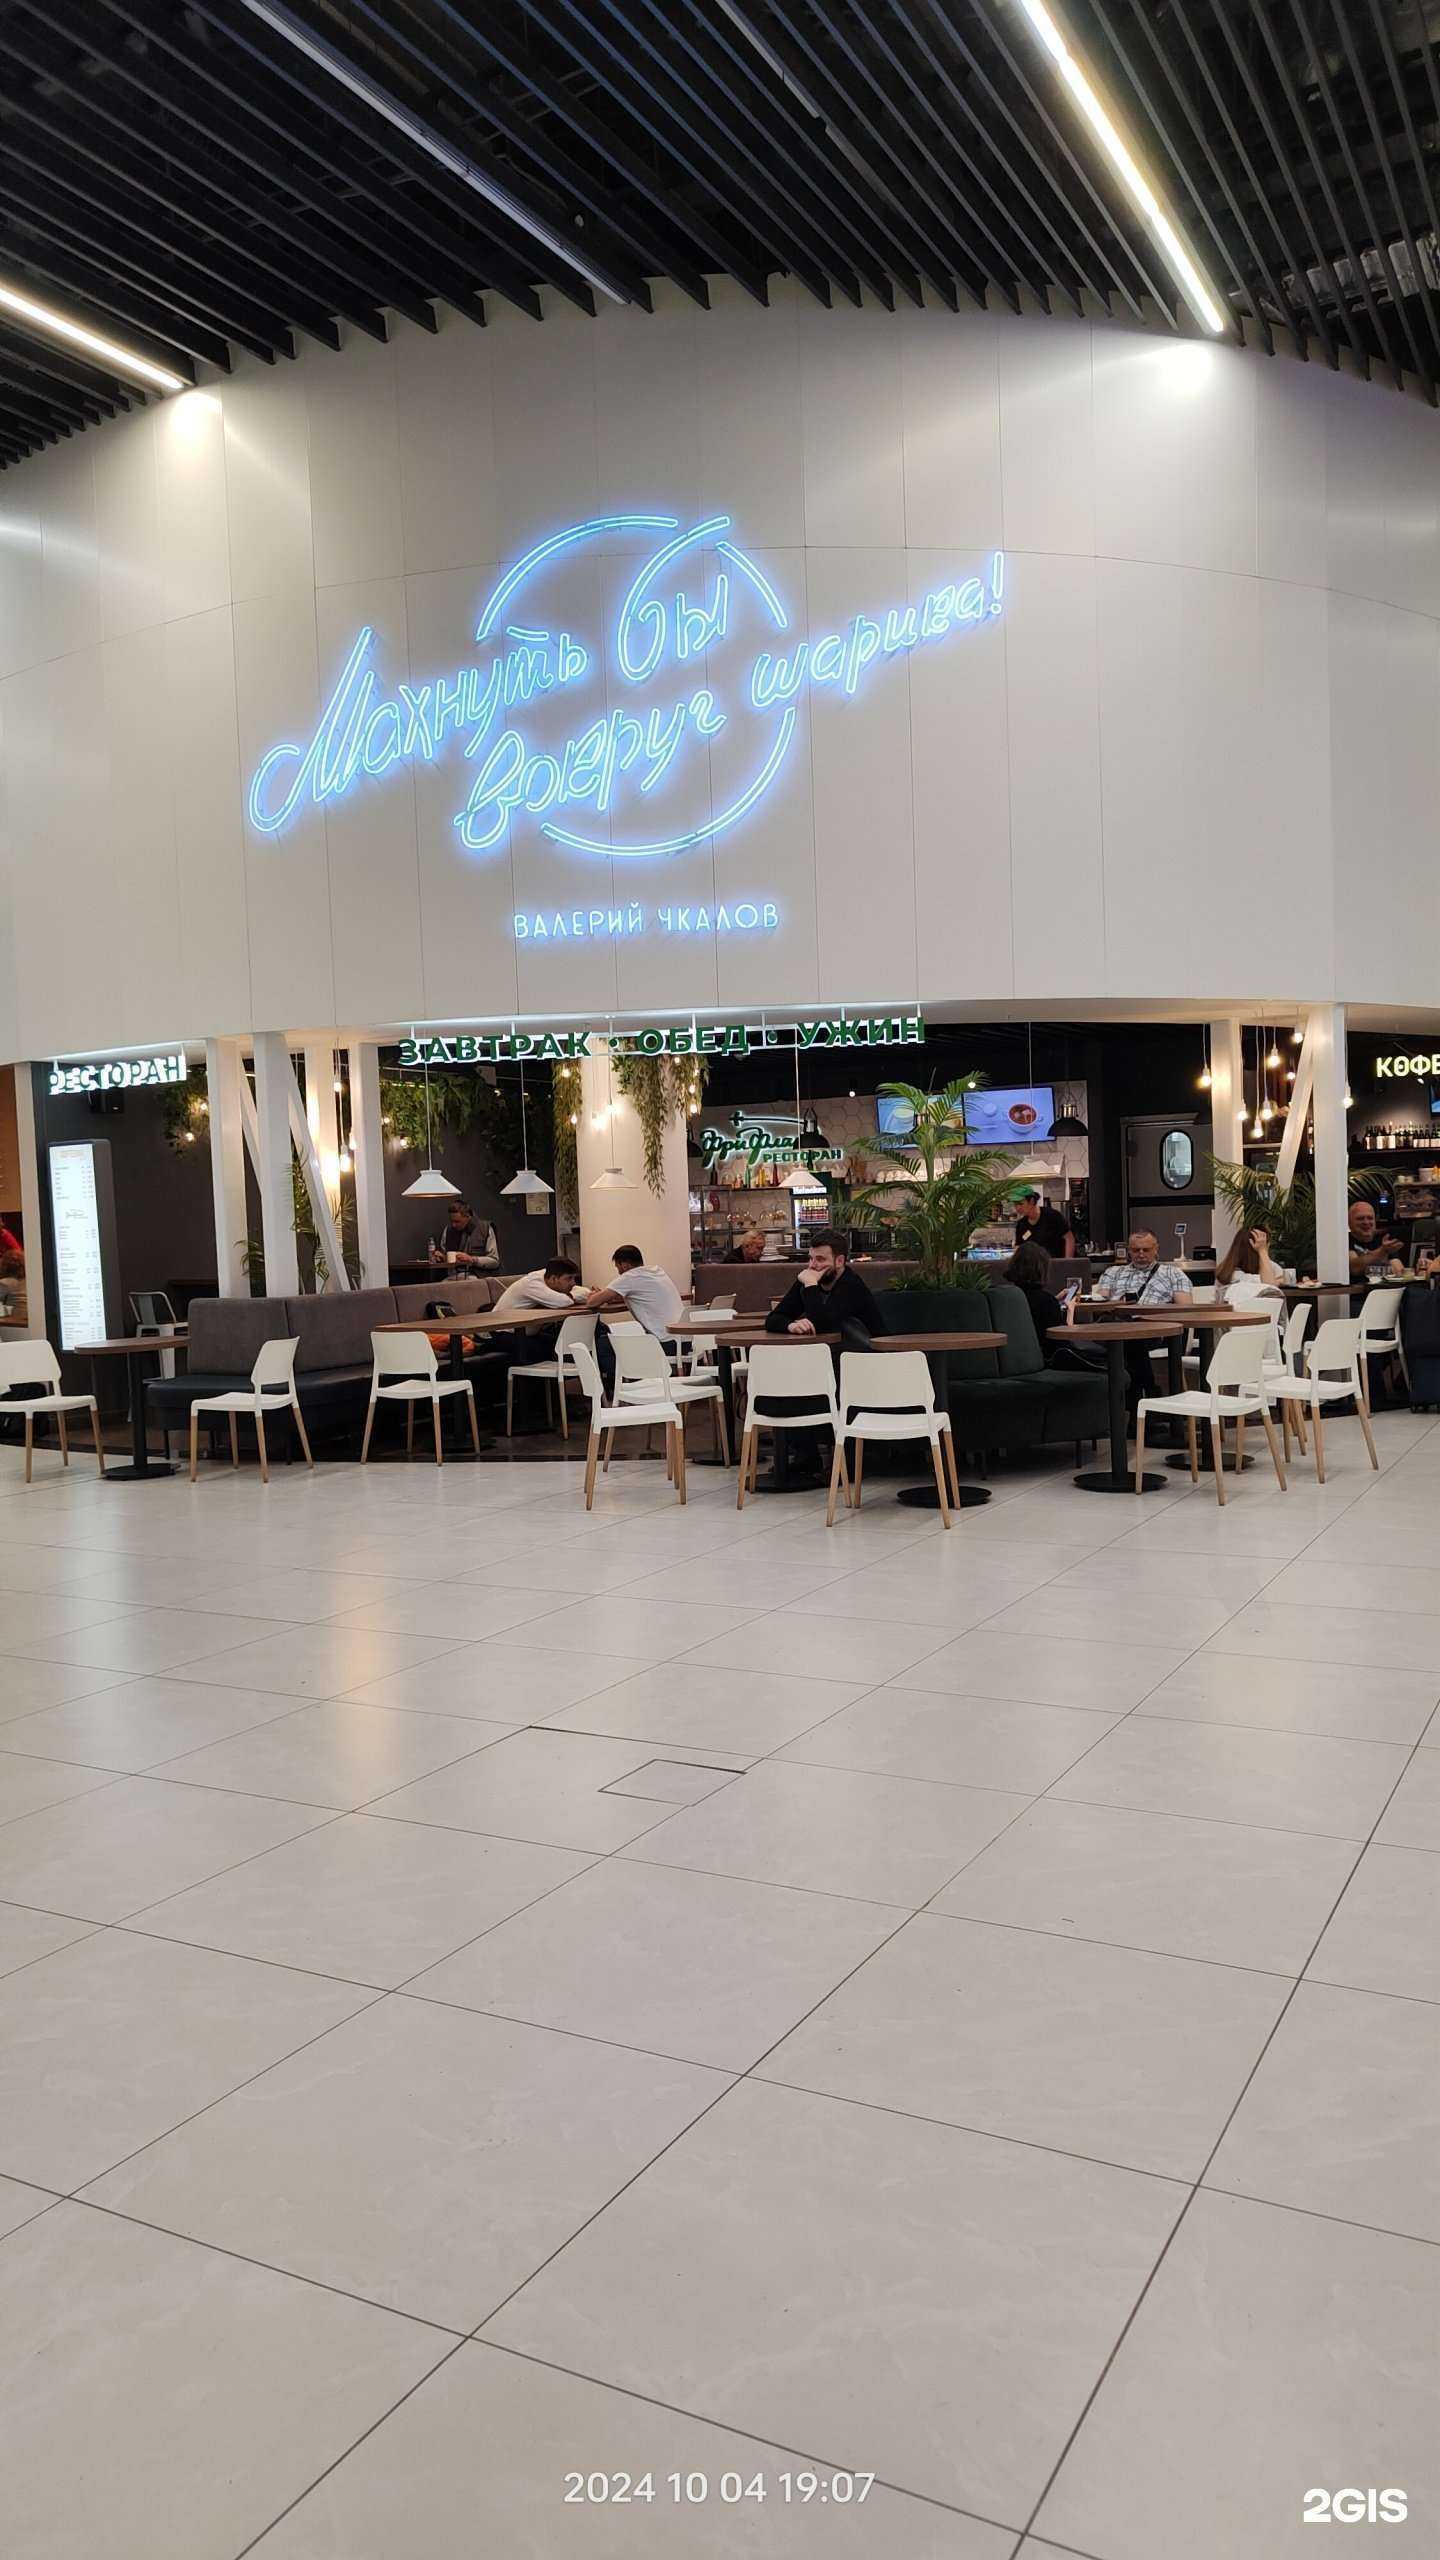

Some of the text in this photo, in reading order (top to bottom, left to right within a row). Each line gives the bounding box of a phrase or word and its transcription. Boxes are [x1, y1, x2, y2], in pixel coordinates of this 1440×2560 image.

[453, 551, 1005, 848] вокруг шарика!
[249, 626, 588, 831] Махнуть
[514, 901, 780, 939] ВАЛЕРИЙ ЧКАЛОВ
[399, 1016, 926, 1066] ЗАВТРАК ОБЕД УЖИН
[48, 1054, 187, 1096] РЕСТОРАН
[762, 1149, 842, 1163] РЕСТОРАН
